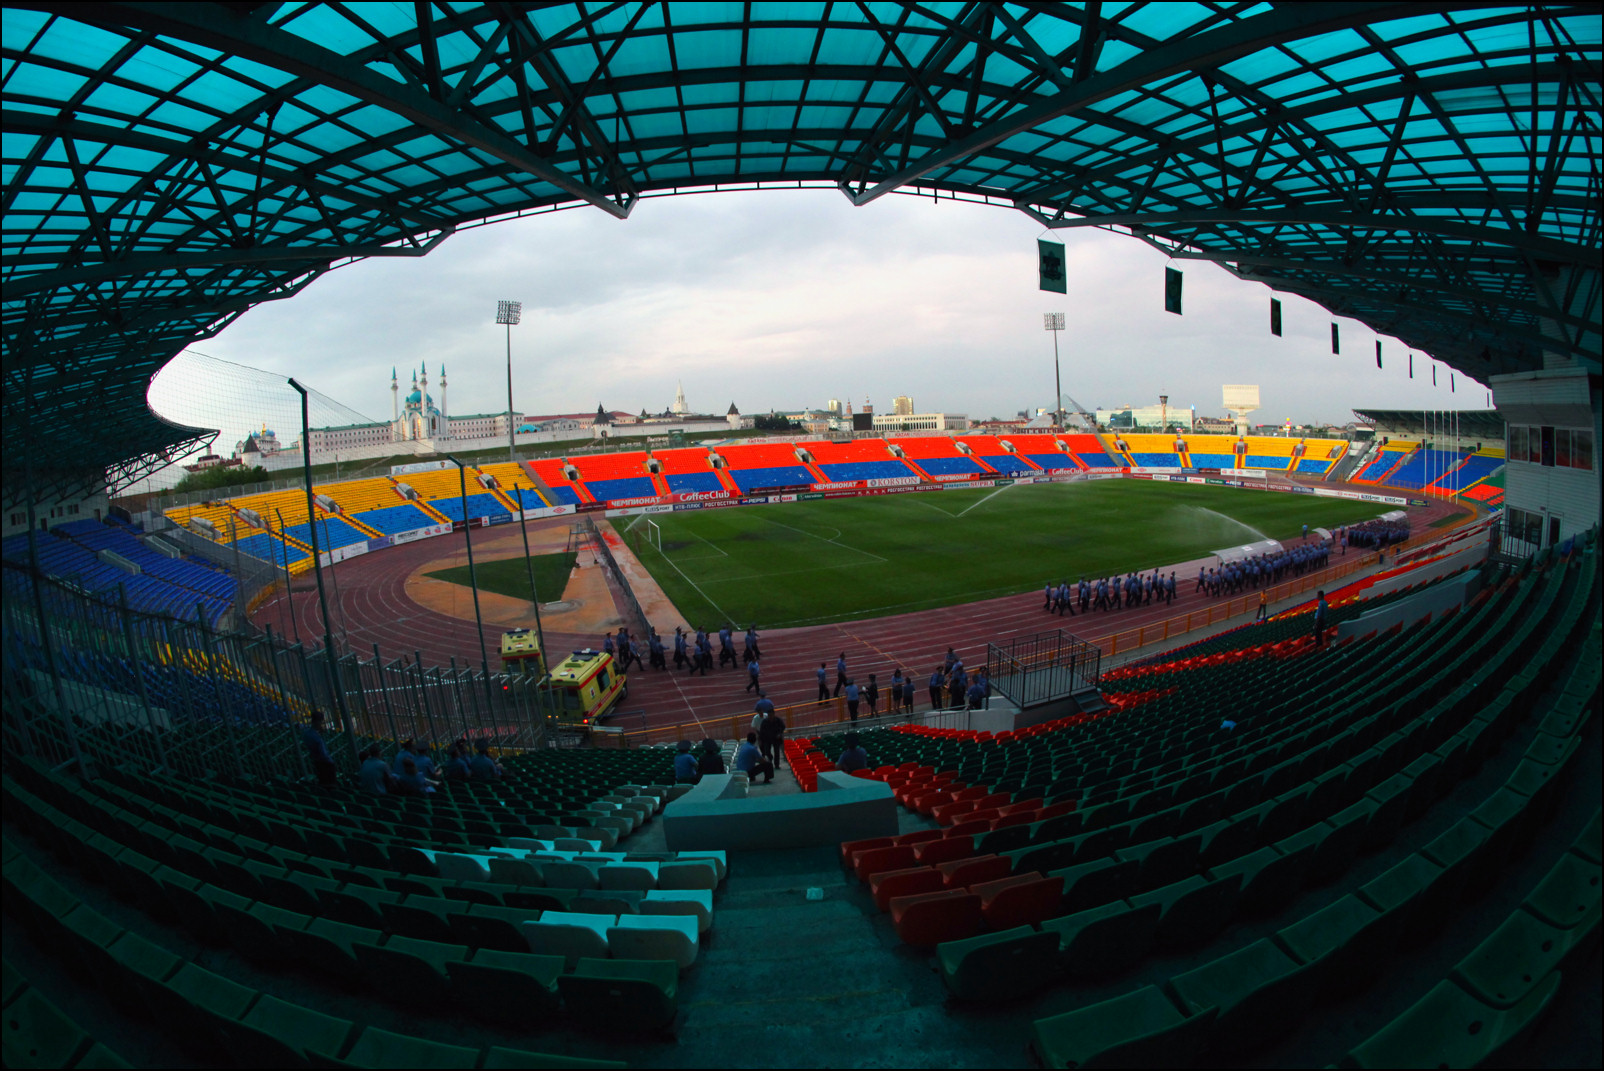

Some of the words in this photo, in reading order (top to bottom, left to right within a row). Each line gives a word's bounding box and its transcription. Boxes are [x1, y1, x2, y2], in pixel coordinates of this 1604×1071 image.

[1020, 469, 1045, 477] parmalat
[814, 481, 857, 490] ЧЕМПИОНАТ
[878, 476, 917, 486] KORSTON
[680, 490, 730, 501] CoffeeClub
[611, 496, 661, 507] ЧЕМПИОНАТ
[704, 500, 739, 508] РОСГОССТРАХ
